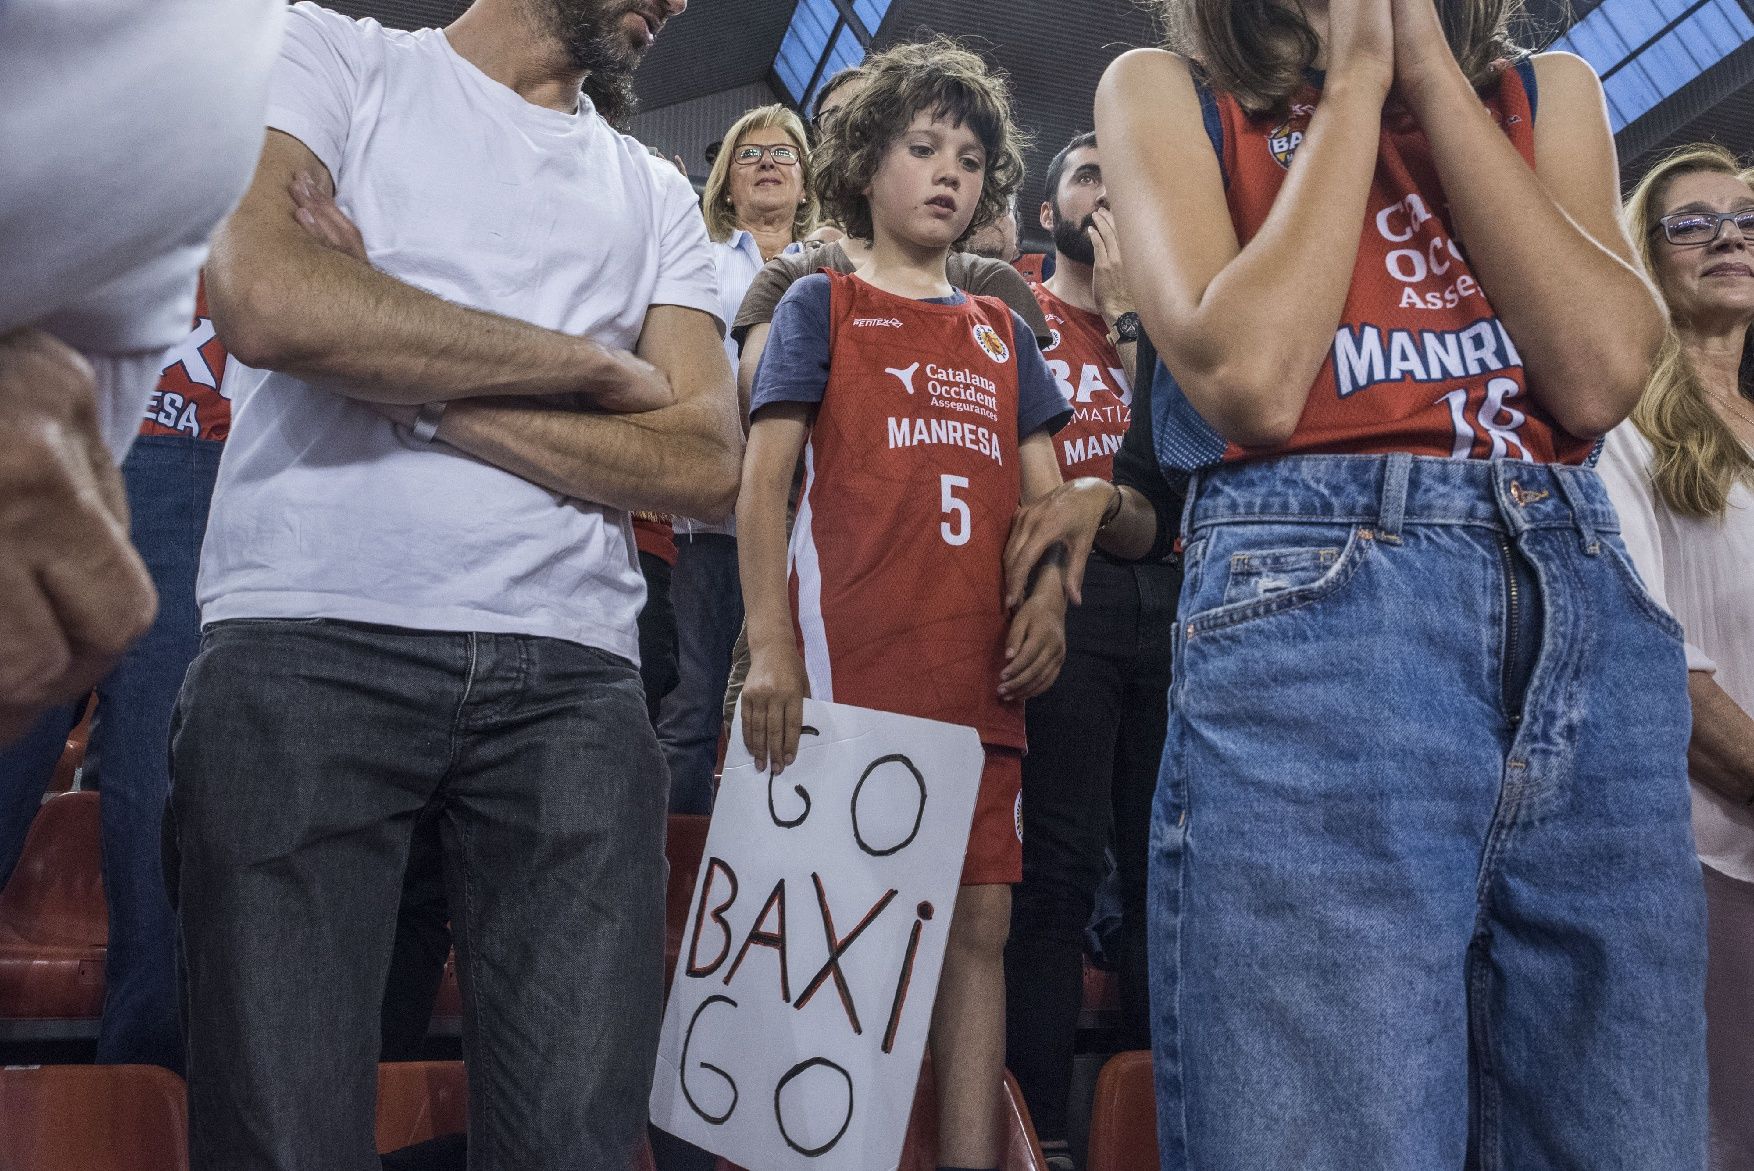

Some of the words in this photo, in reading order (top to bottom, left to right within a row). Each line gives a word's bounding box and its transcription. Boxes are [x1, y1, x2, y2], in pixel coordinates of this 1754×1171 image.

[1399, 274, 1485, 310] Asse
[925, 363, 997, 395] Catalana
[927, 380, 998, 412] Occident
[930, 397, 998, 422] Assegurances
[887, 416, 1003, 467] MANRESA
[940, 473, 972, 546] 5
[768, 725, 928, 858] GO
[680, 993, 855, 1158] GO
